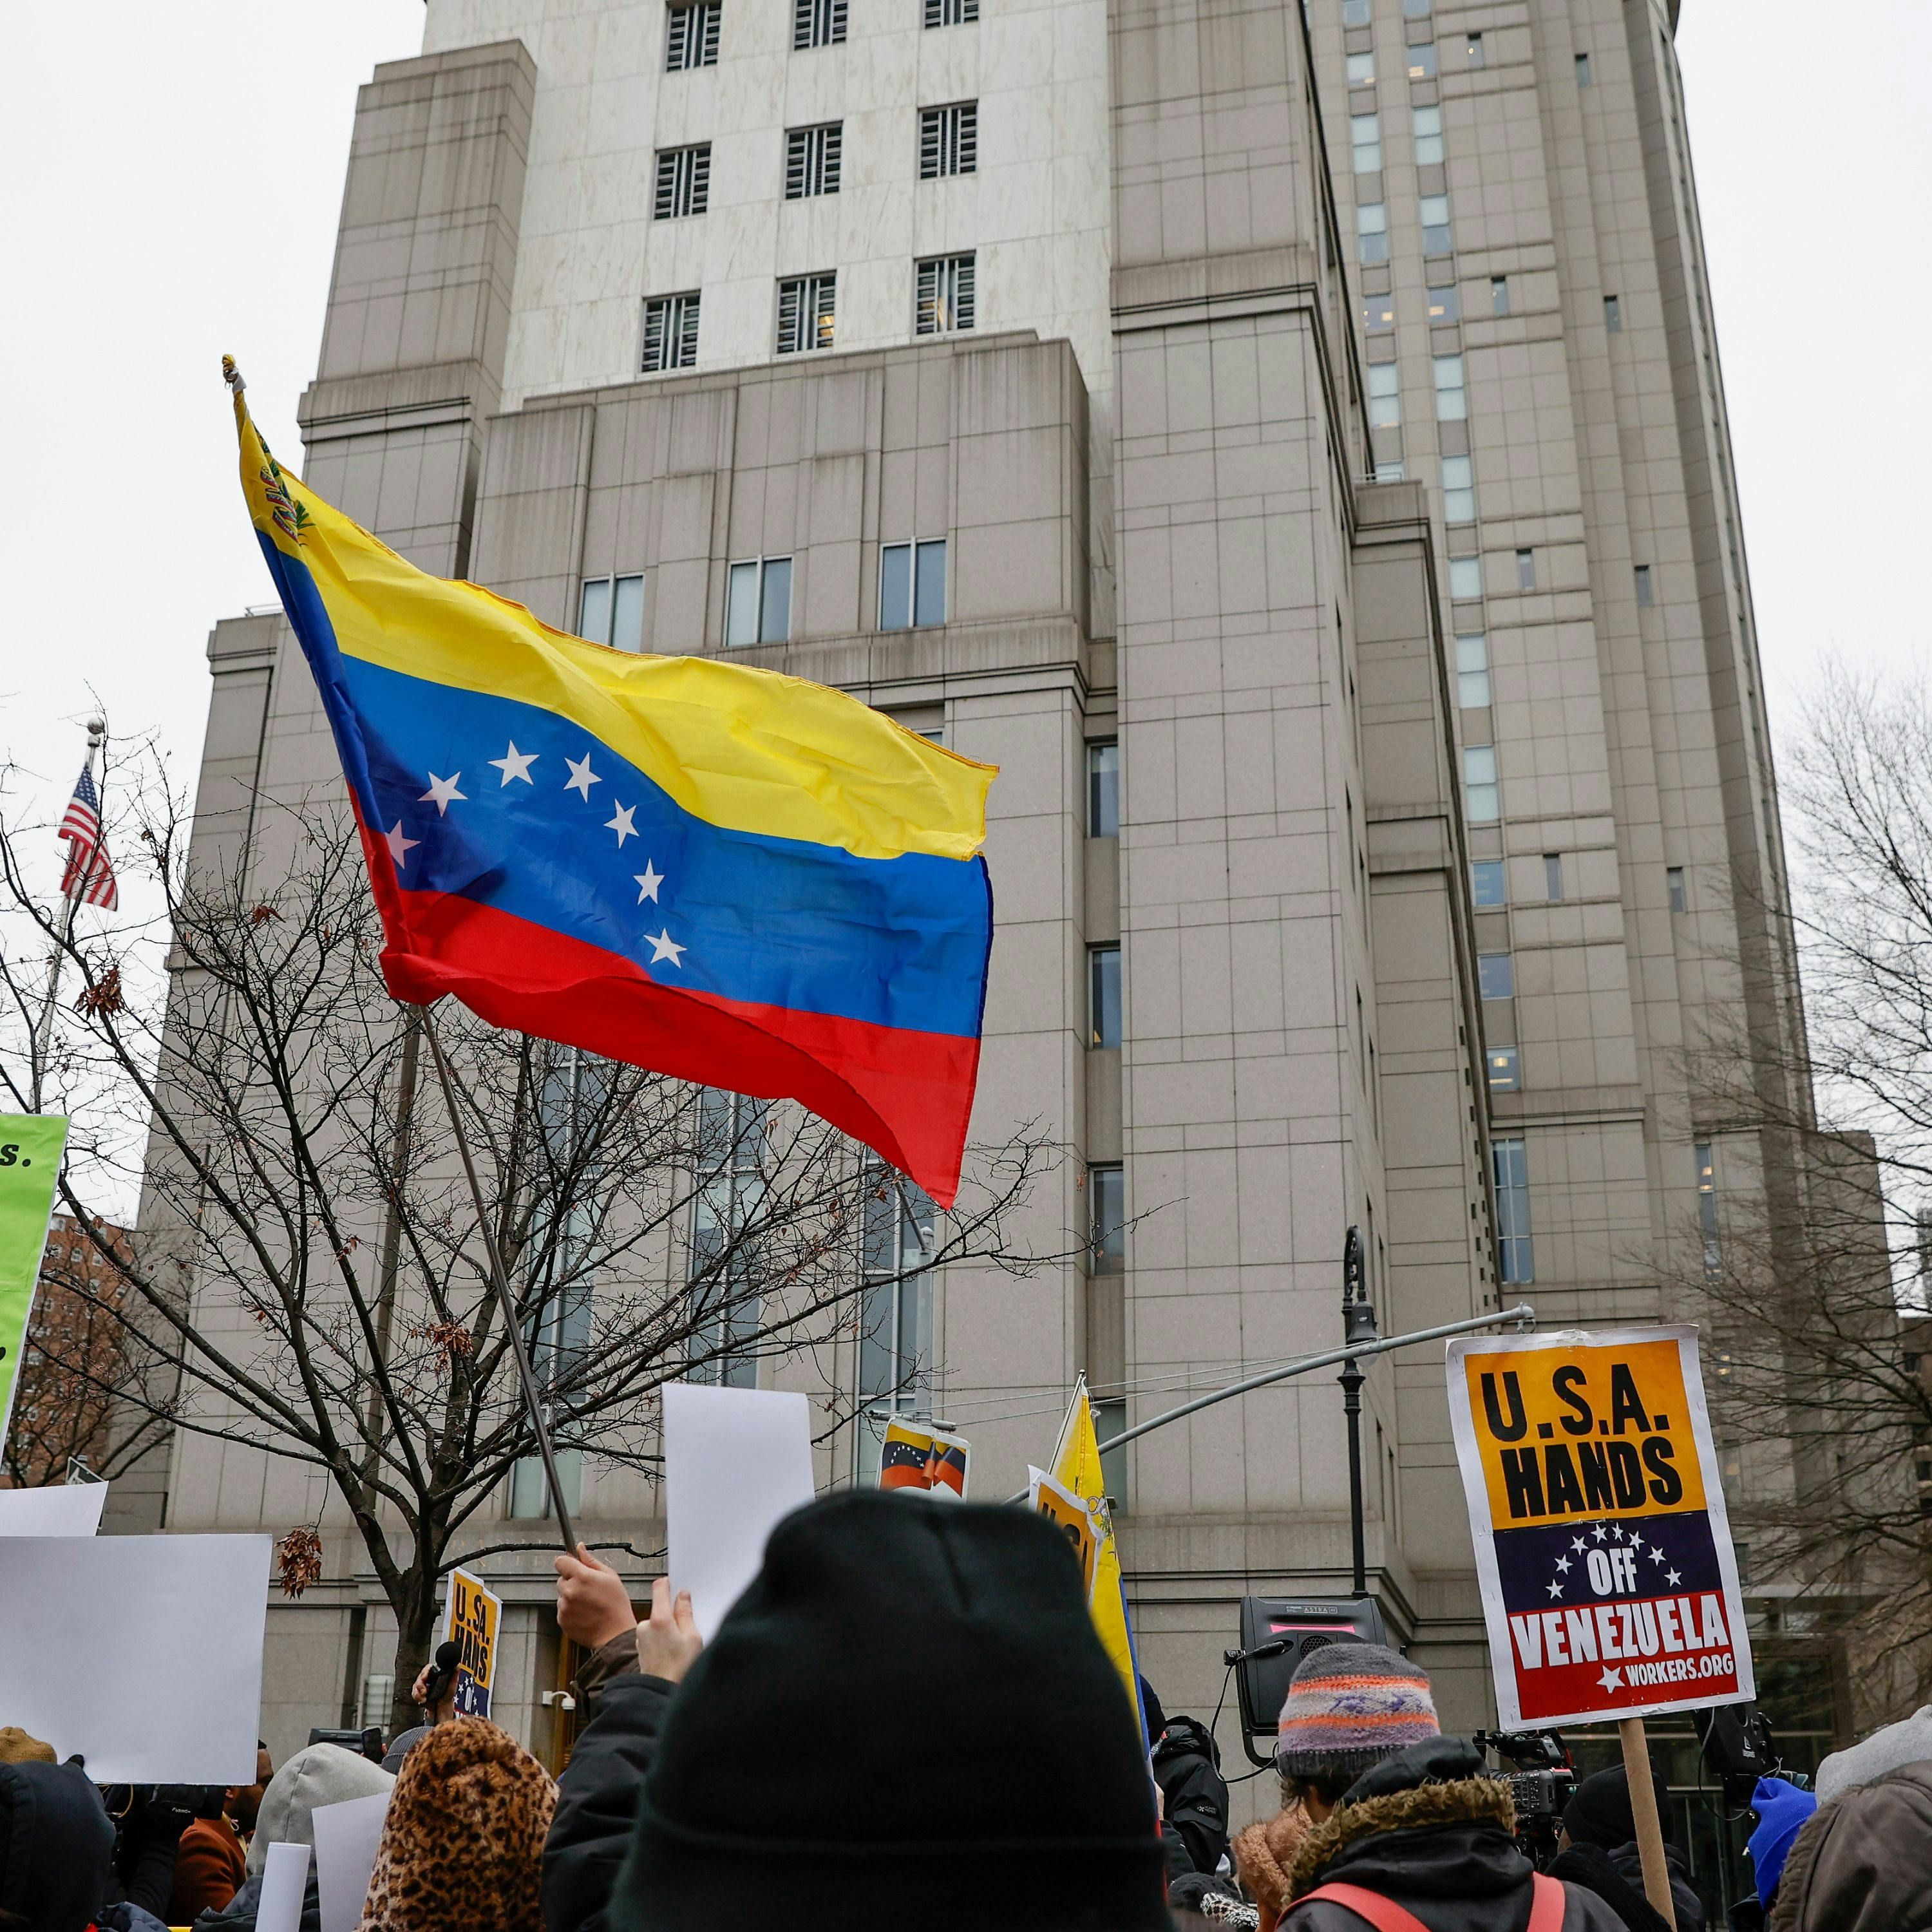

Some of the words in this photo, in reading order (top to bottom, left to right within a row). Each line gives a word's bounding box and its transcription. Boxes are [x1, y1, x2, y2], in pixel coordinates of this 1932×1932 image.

[1481, 1363, 1670, 1442] U.S.A.
[1499, 1436, 1683, 1519] HANDS
[1586, 1548, 1638, 1596] OFF
[1510, 1594, 1730, 1670] VENEZUELA
[1625, 1653, 1734, 1687] WORKERS.ORG
